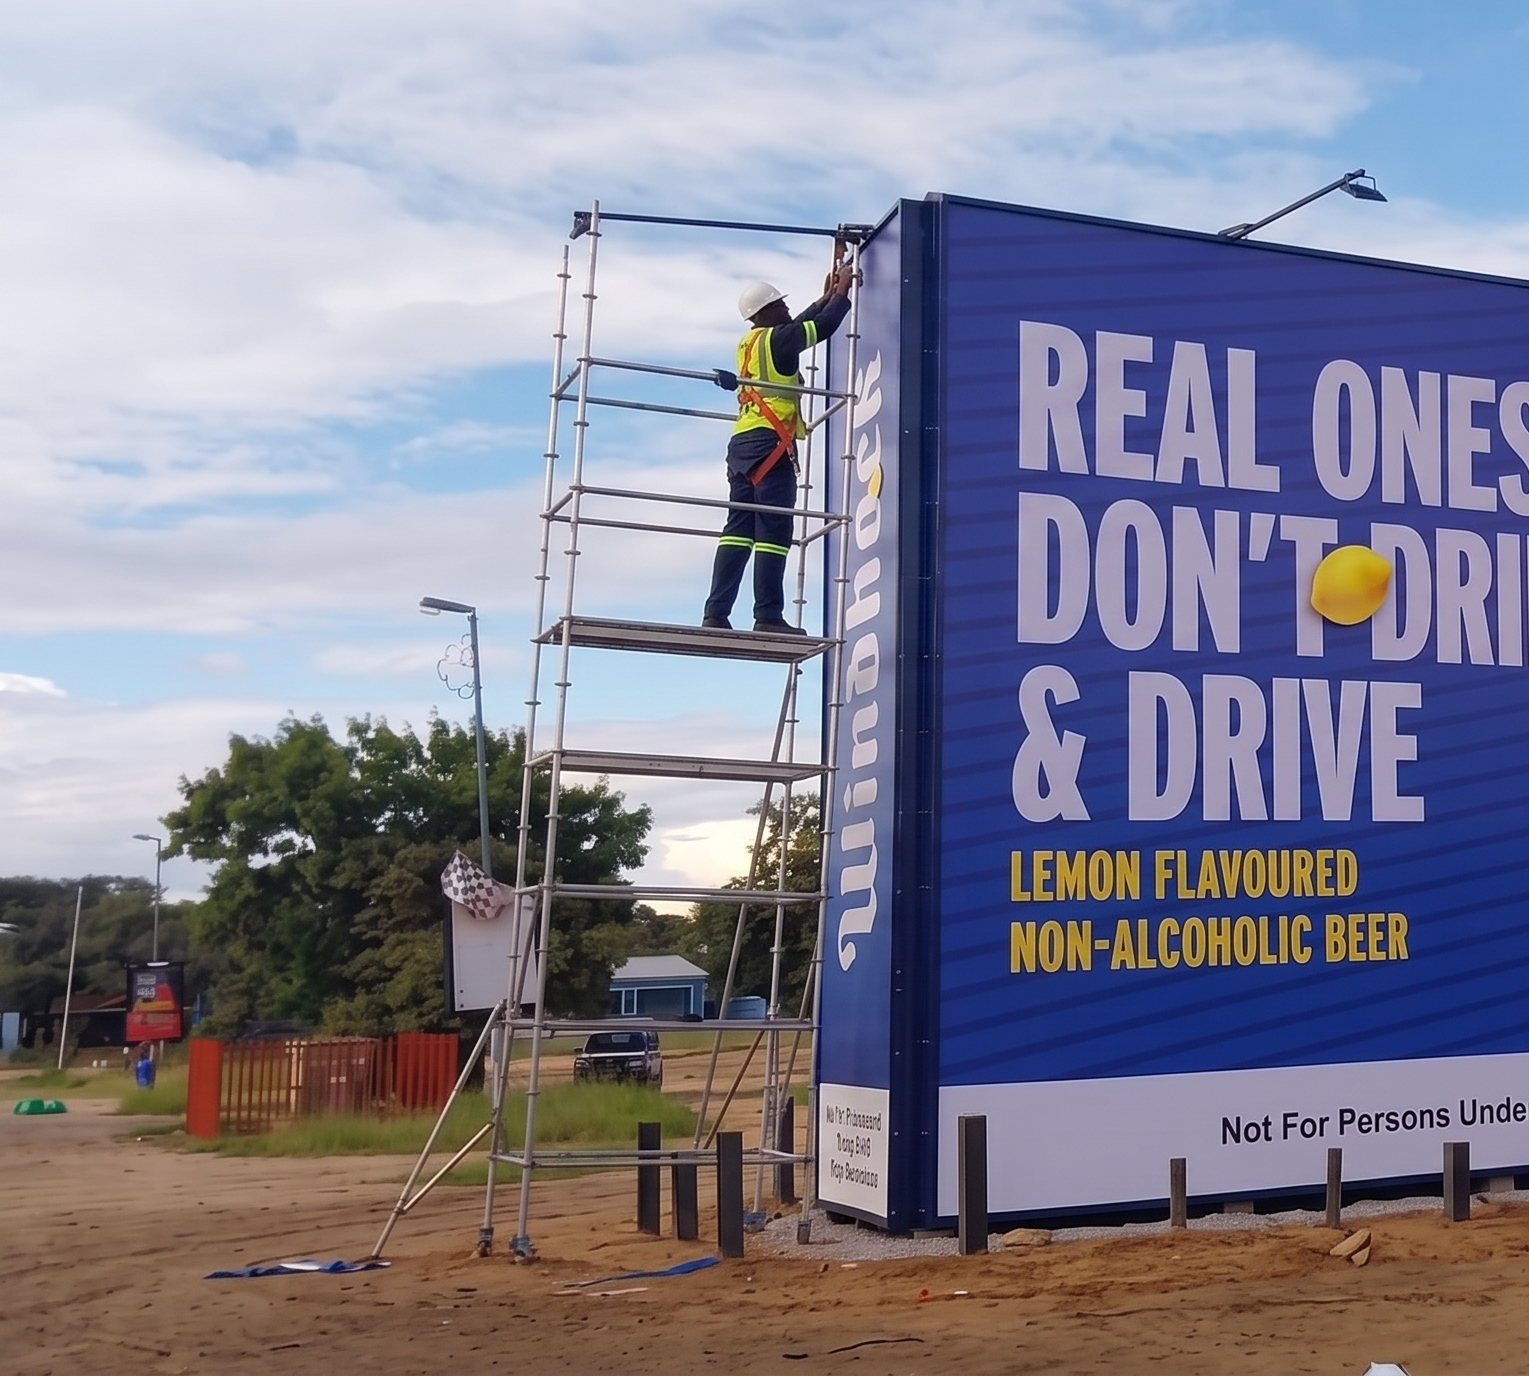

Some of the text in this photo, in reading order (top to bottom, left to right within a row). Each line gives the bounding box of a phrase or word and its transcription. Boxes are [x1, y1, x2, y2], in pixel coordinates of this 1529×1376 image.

[1018, 320, 1281, 493] REAL
[1018, 491, 1339, 658] DON'T
[1011, 664, 1425, 823] & DRIVE
[1010, 850, 1358, 901] LEMON FLAVOURED
[1010, 914, 1409, 972] NON-ALCOHOLIC BEER
[1222, 1114, 1273, 1145] Not
[1282, 1111, 1331, 1140] For
[1338, 1108, 1451, 1136] Persons
